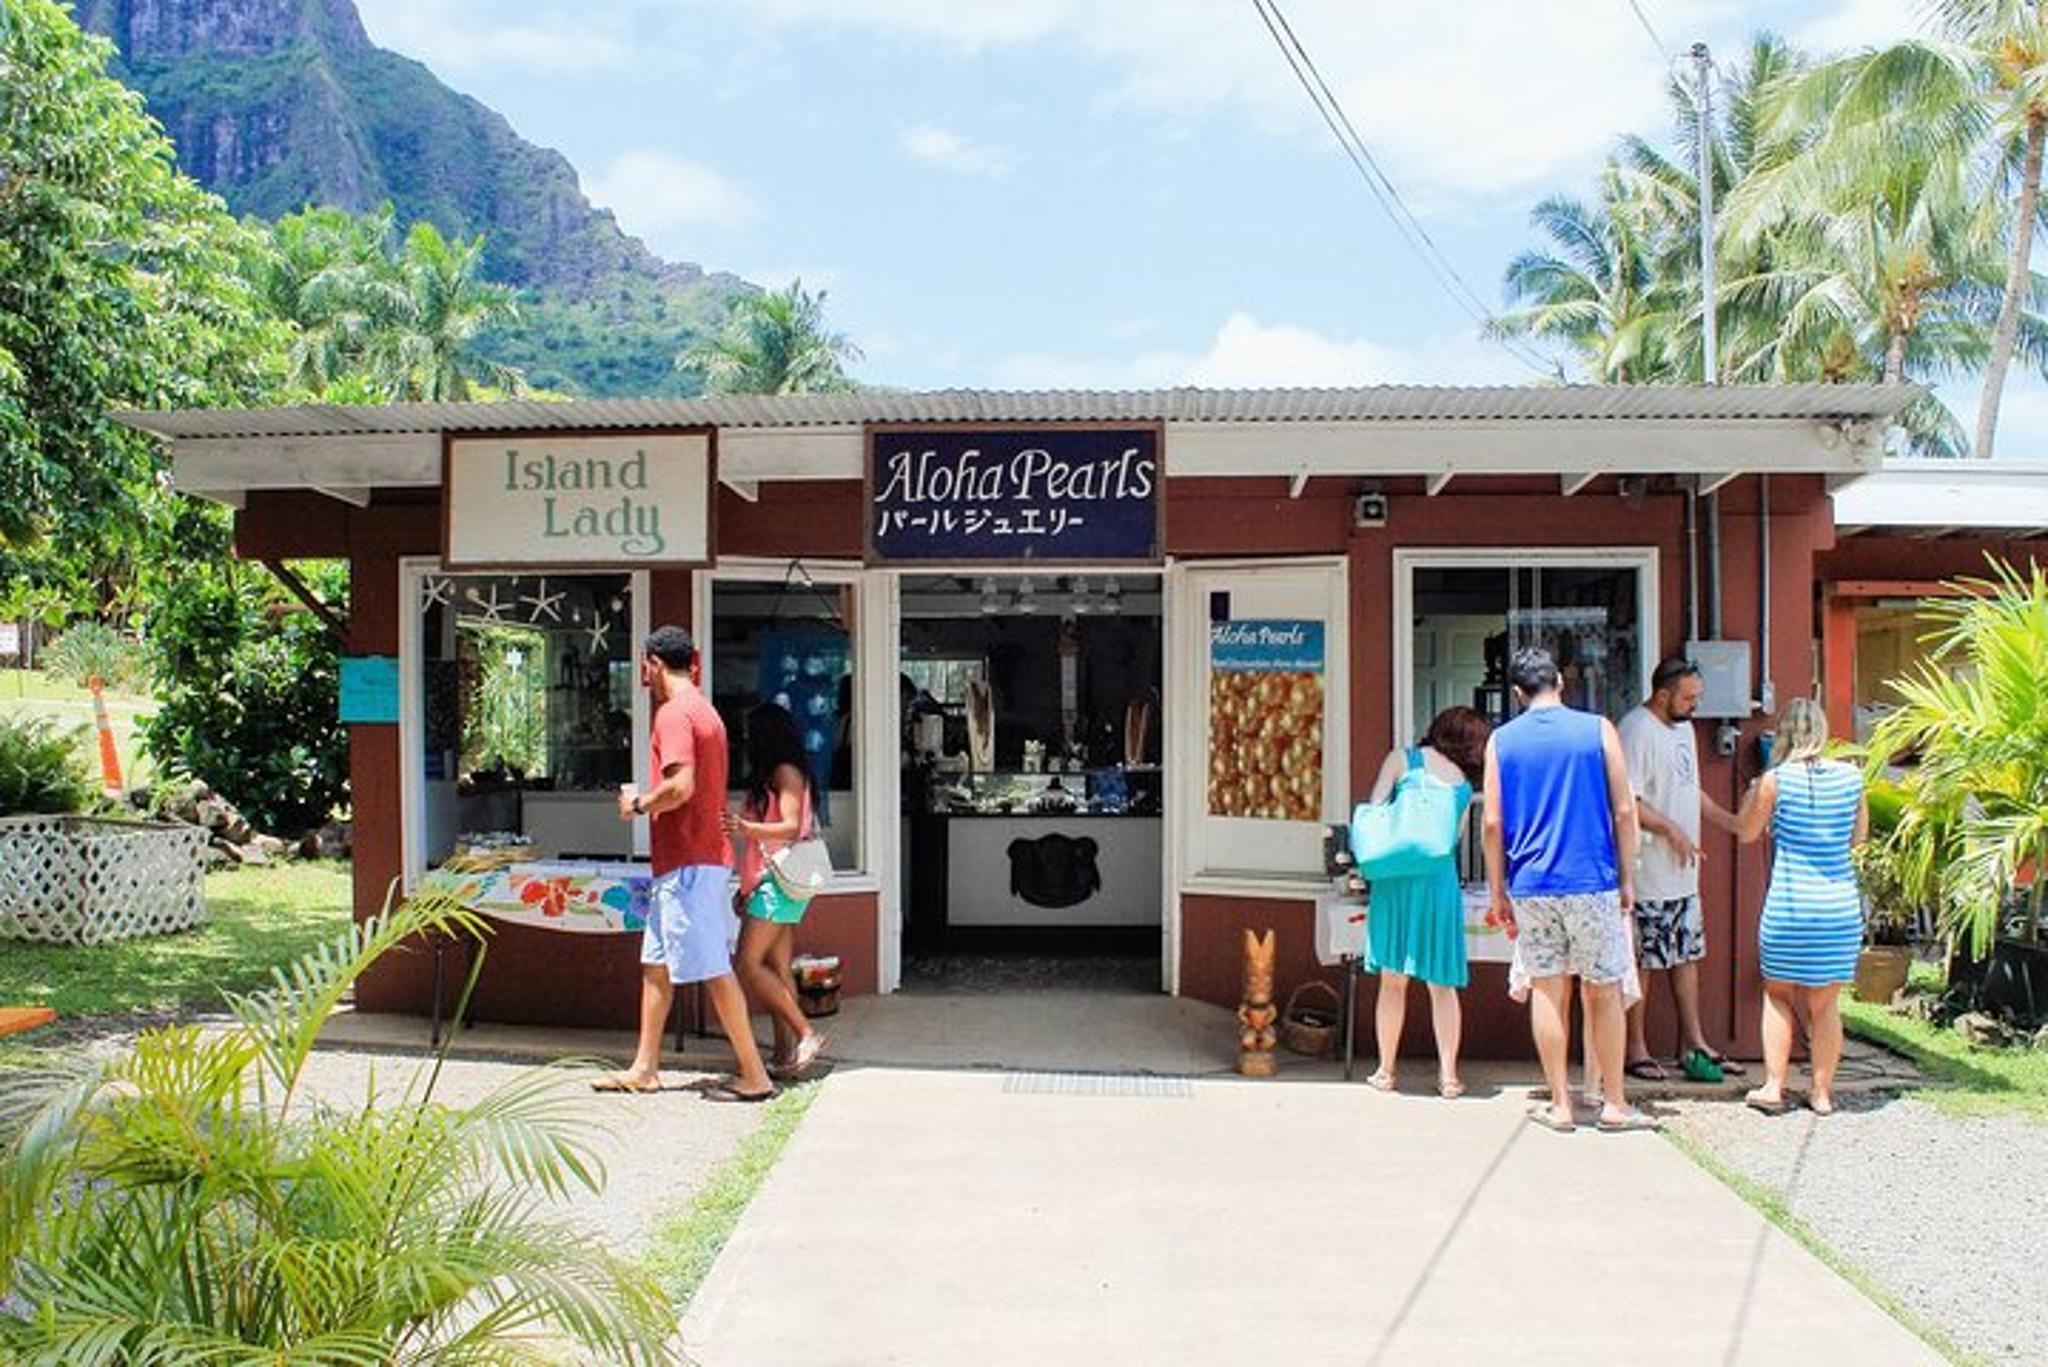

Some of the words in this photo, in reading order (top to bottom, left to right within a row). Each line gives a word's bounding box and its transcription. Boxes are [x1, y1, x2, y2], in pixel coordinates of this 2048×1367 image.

[506, 450, 648, 490] Island
[874, 450, 1003, 502] Aloha
[1009, 449, 1156, 500] Pearls
[543, 497, 665, 555] Lady
[1210, 624, 1257, 644] Aloha
[1258, 623, 1304, 644] Pearls
